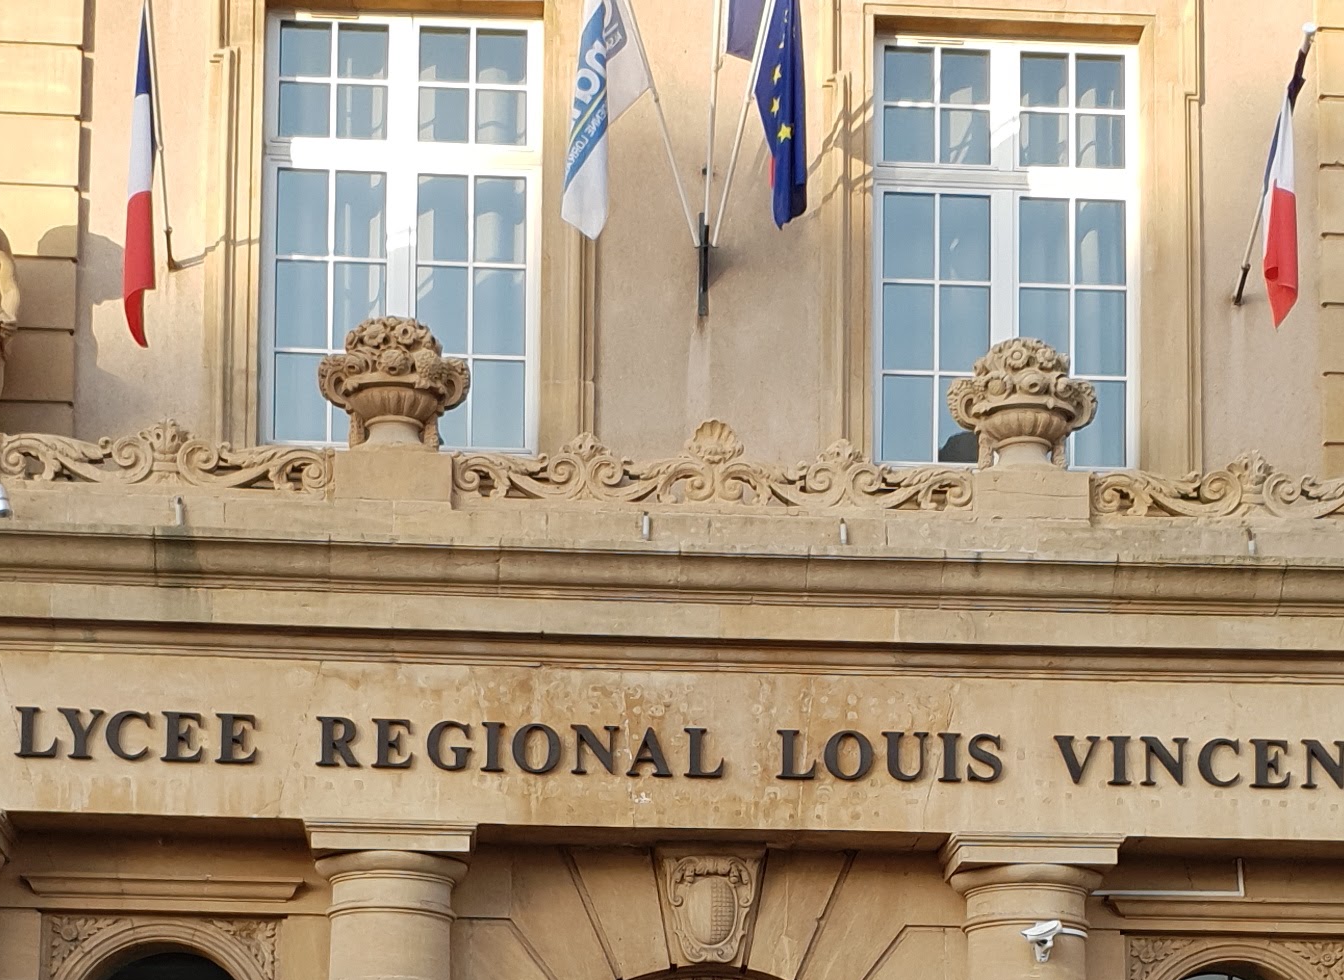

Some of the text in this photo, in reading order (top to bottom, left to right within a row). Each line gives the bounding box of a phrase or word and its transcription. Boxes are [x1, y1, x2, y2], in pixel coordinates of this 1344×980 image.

[15, 705, 258, 764] LYCEE
[316, 716, 725, 778] REGIONAL
[776, 729, 1003, 783] LOUIS
